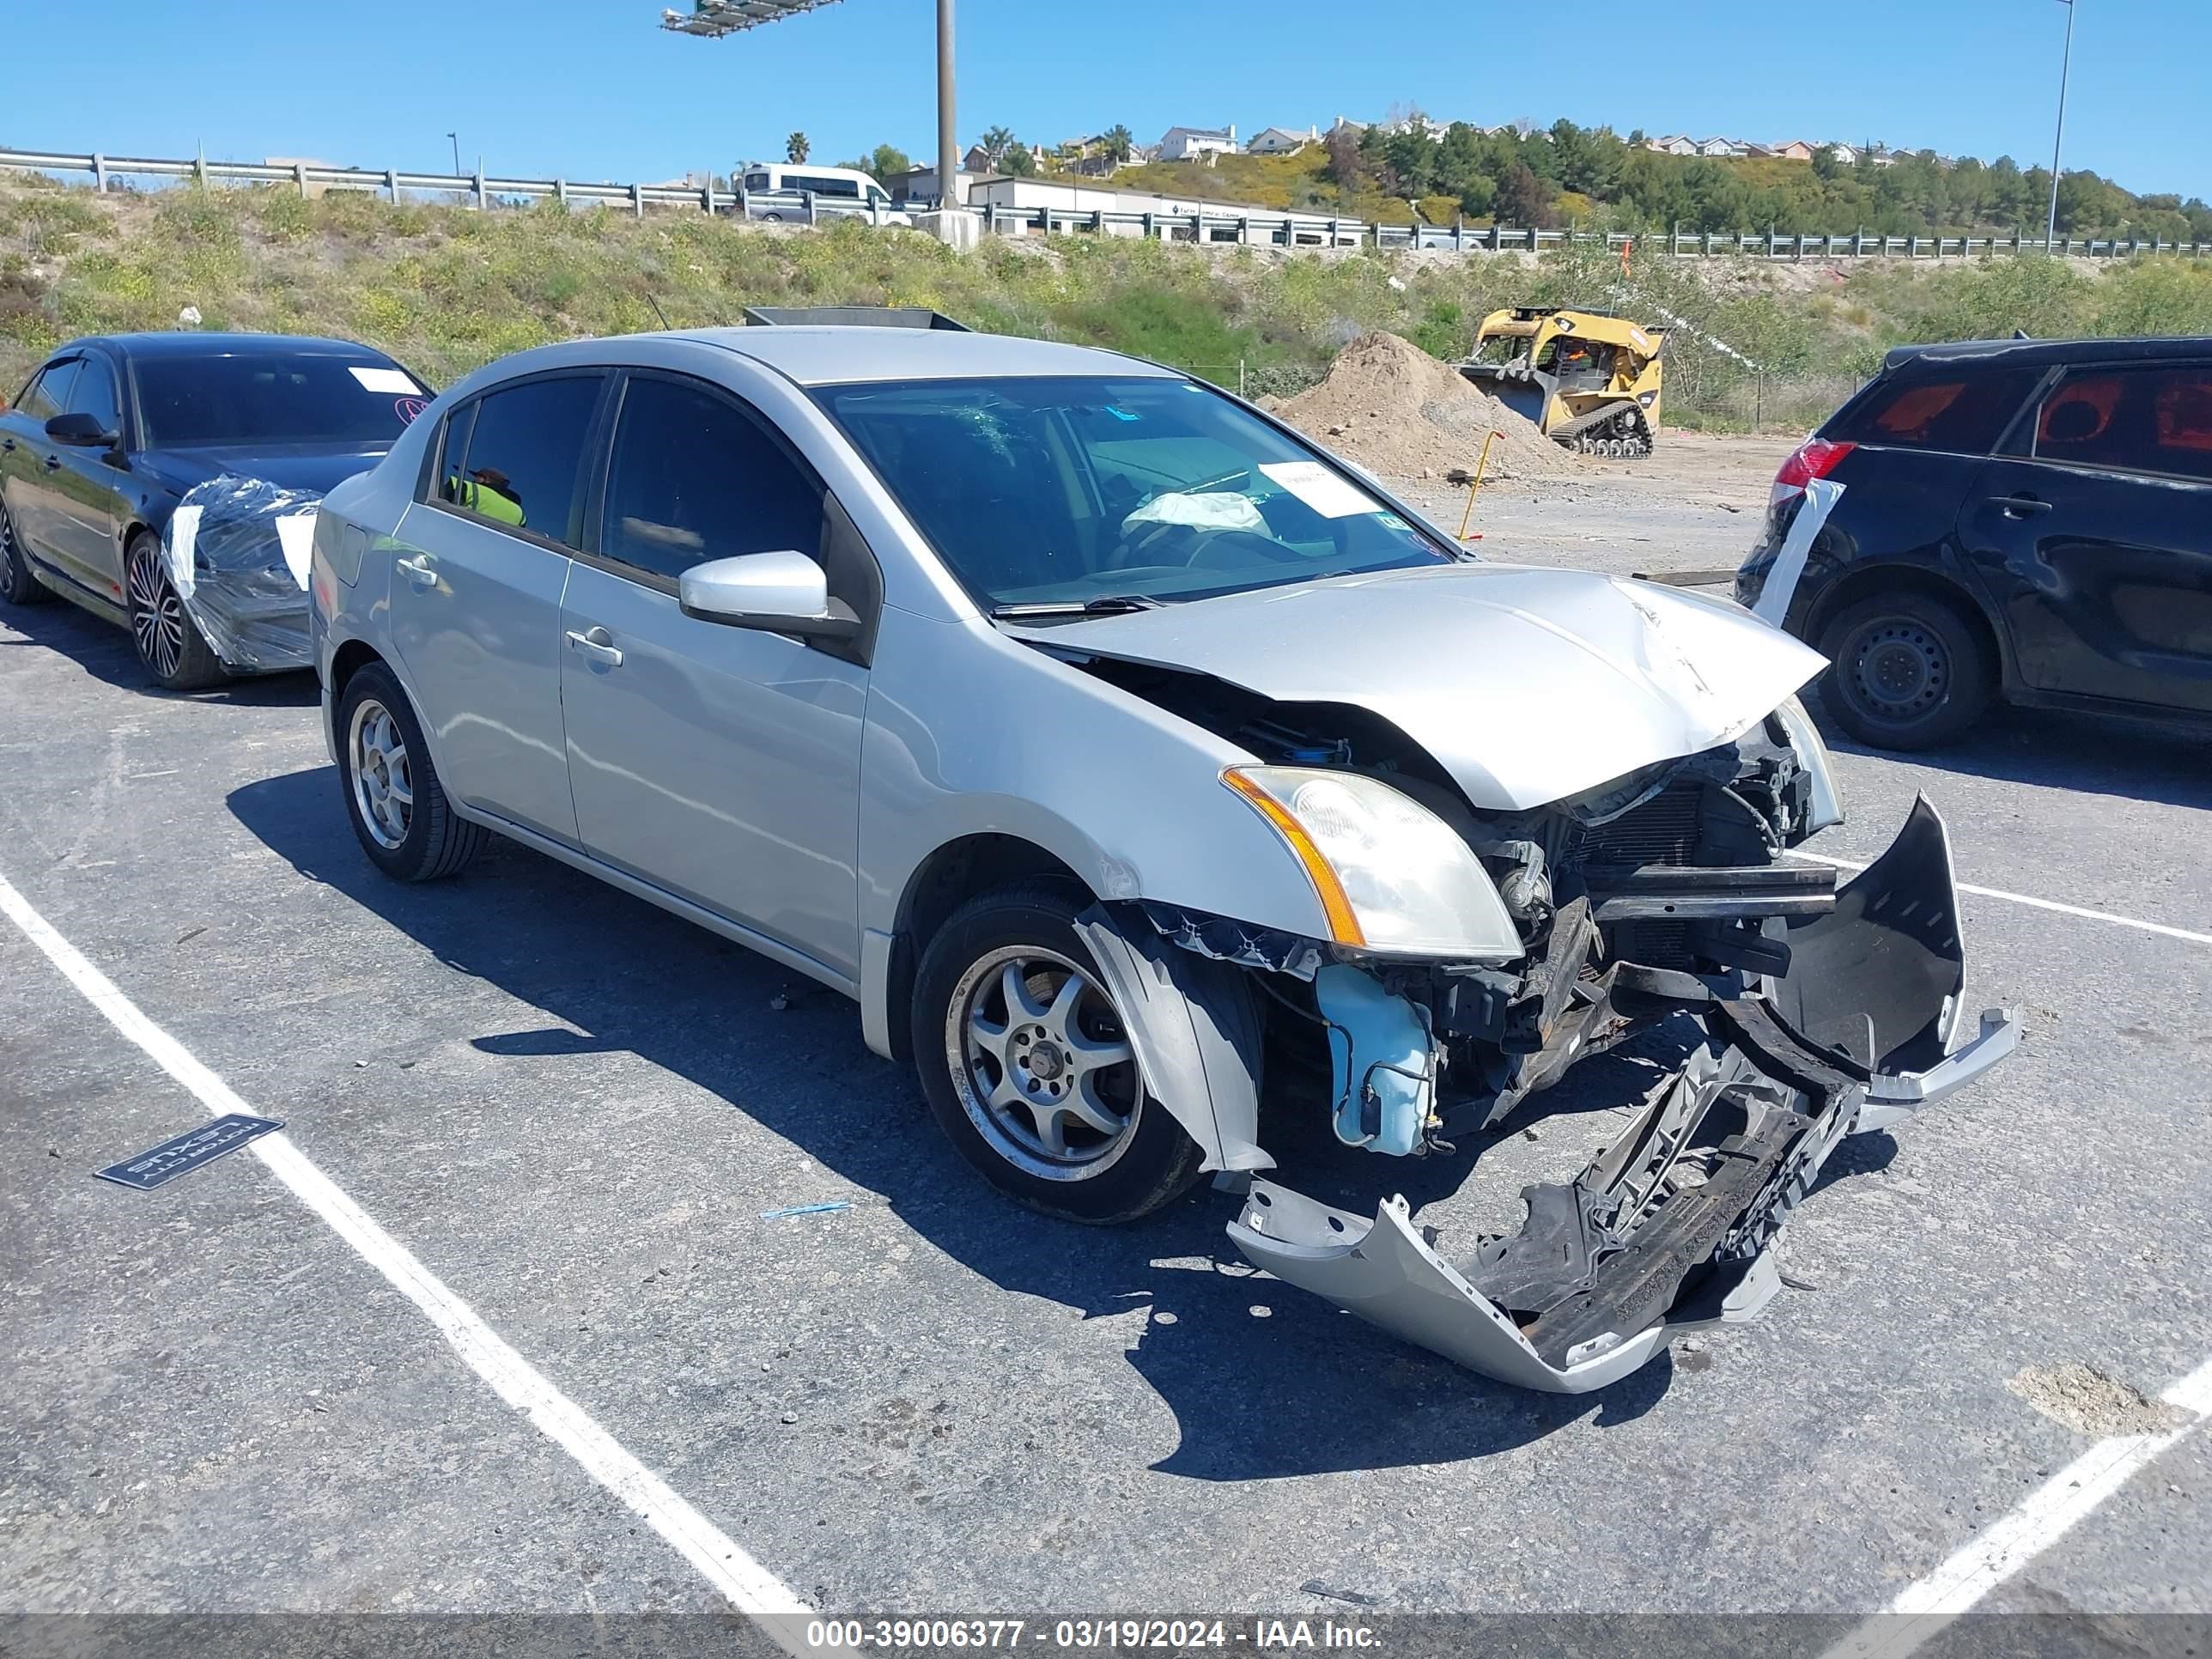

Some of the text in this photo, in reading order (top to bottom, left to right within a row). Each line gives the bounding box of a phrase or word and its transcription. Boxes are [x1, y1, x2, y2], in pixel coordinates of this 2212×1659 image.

[126, 1121, 241, 1174] LEXUS
[143, 1121, 261, 1181] MOTOR CITY
